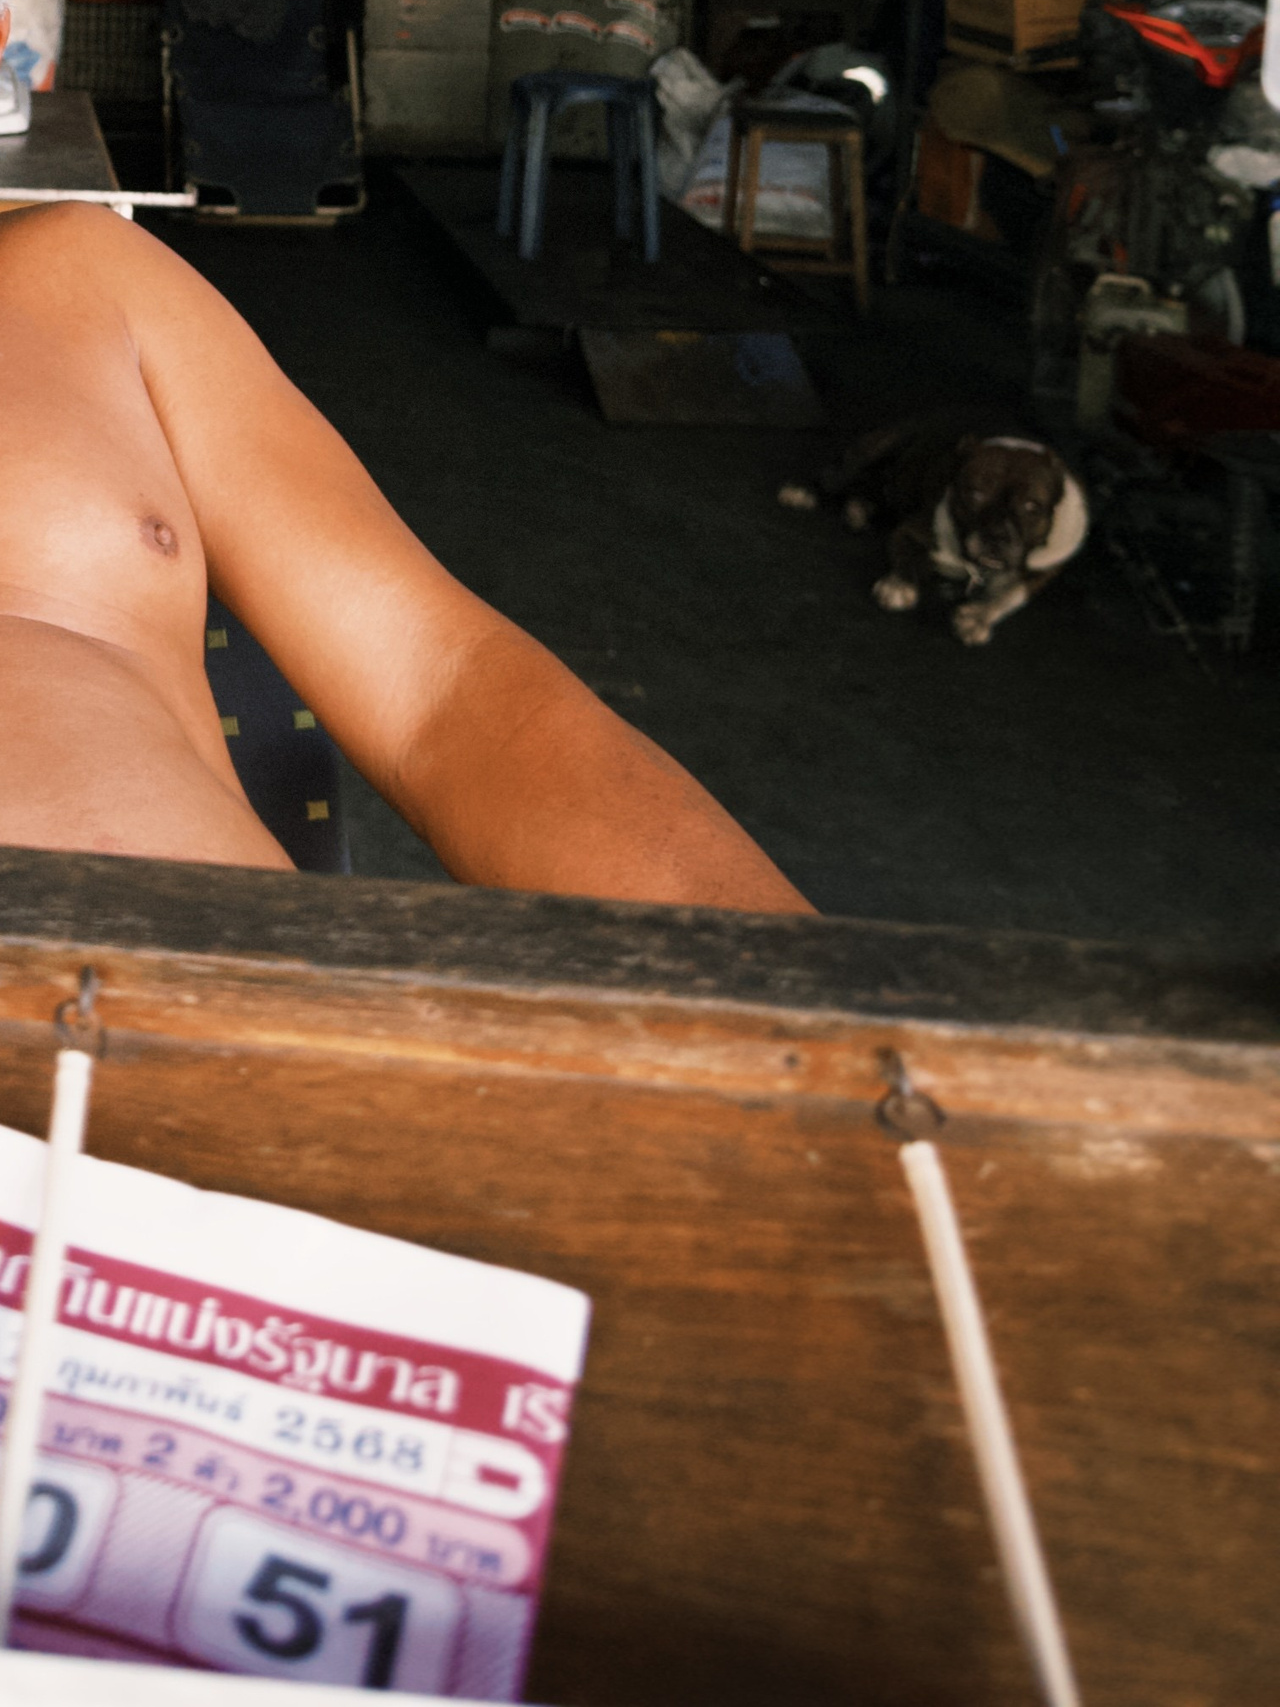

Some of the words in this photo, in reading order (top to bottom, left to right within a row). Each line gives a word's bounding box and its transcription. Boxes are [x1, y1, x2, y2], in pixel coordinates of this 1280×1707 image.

[142, 1431, 178, 1468] 2
[274, 1405, 426, 1474] 2568
[232, 1552, 411, 1690] 51
